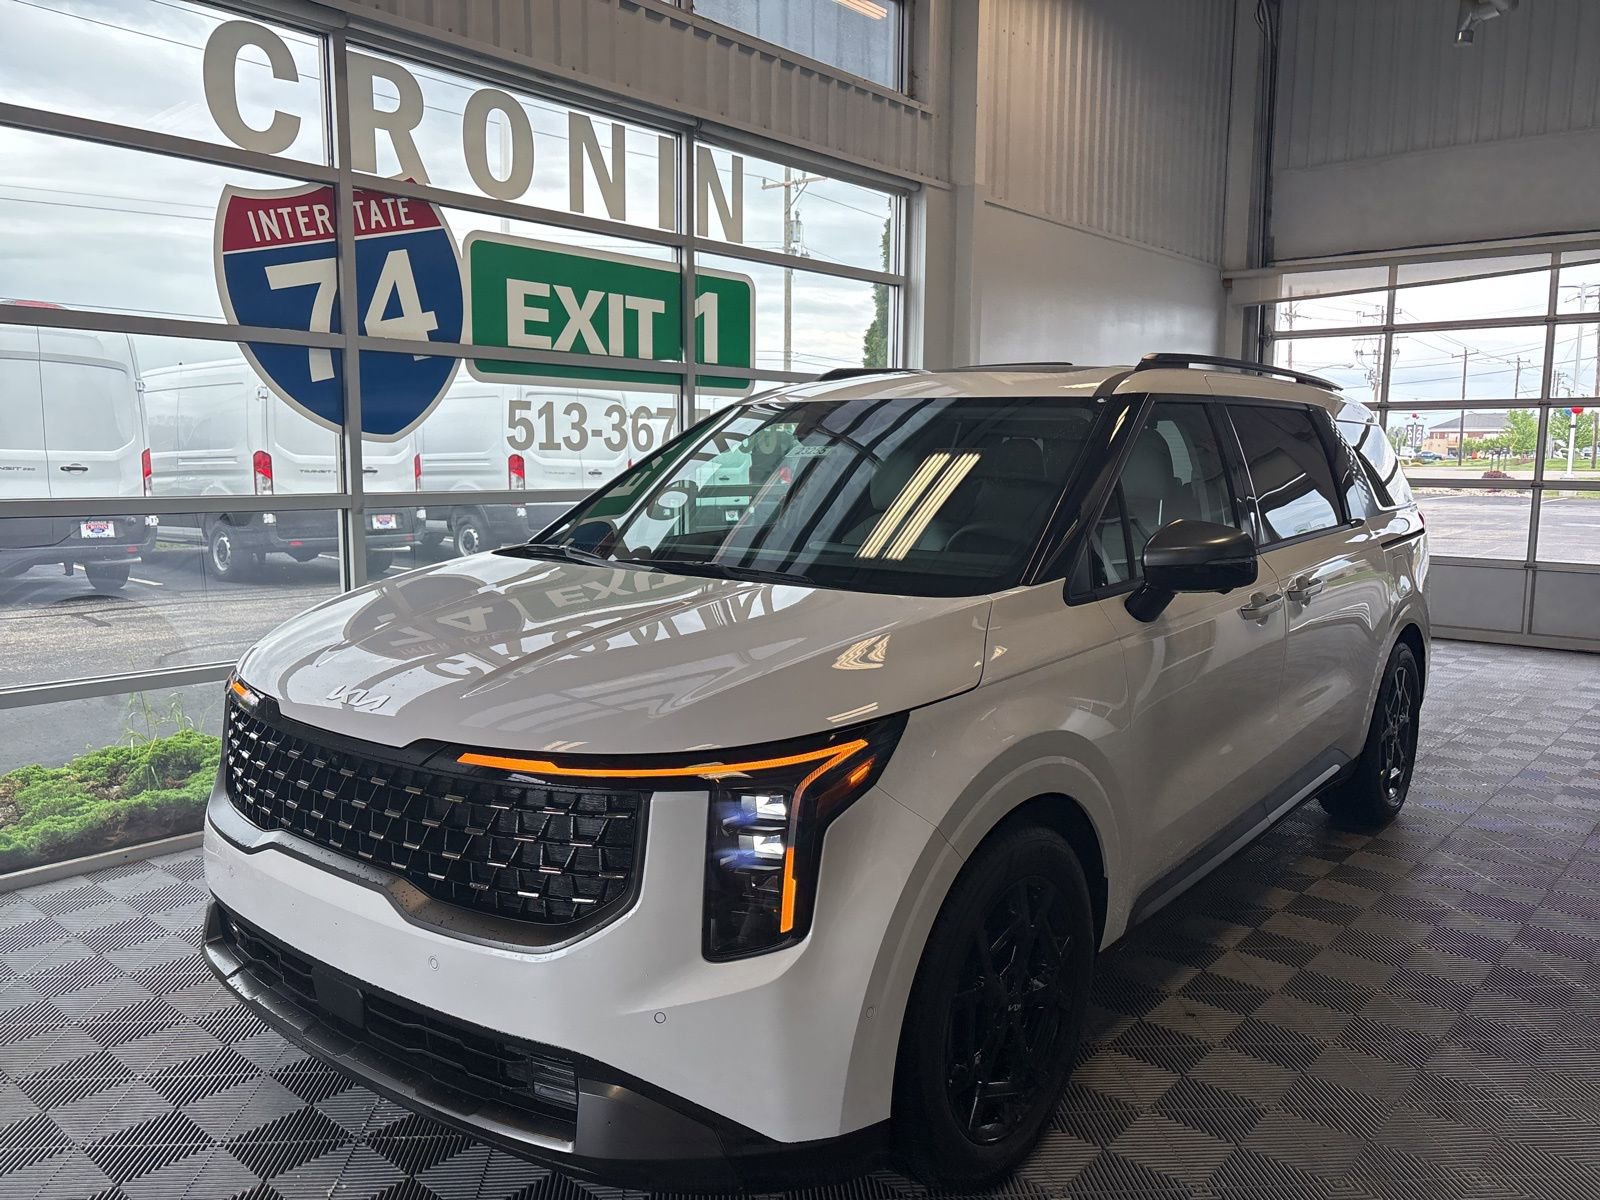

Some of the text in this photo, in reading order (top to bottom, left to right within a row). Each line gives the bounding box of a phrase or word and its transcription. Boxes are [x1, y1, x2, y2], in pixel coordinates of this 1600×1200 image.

[203, 20, 743, 244] CRONIN
[247, 198, 415, 242] INTERTATE
[264, 249, 439, 383] 74
[506, 278, 718, 364] EXIT 1
[507, 399, 711, 451] 513-367
[324, 683, 392, 712] KIA
